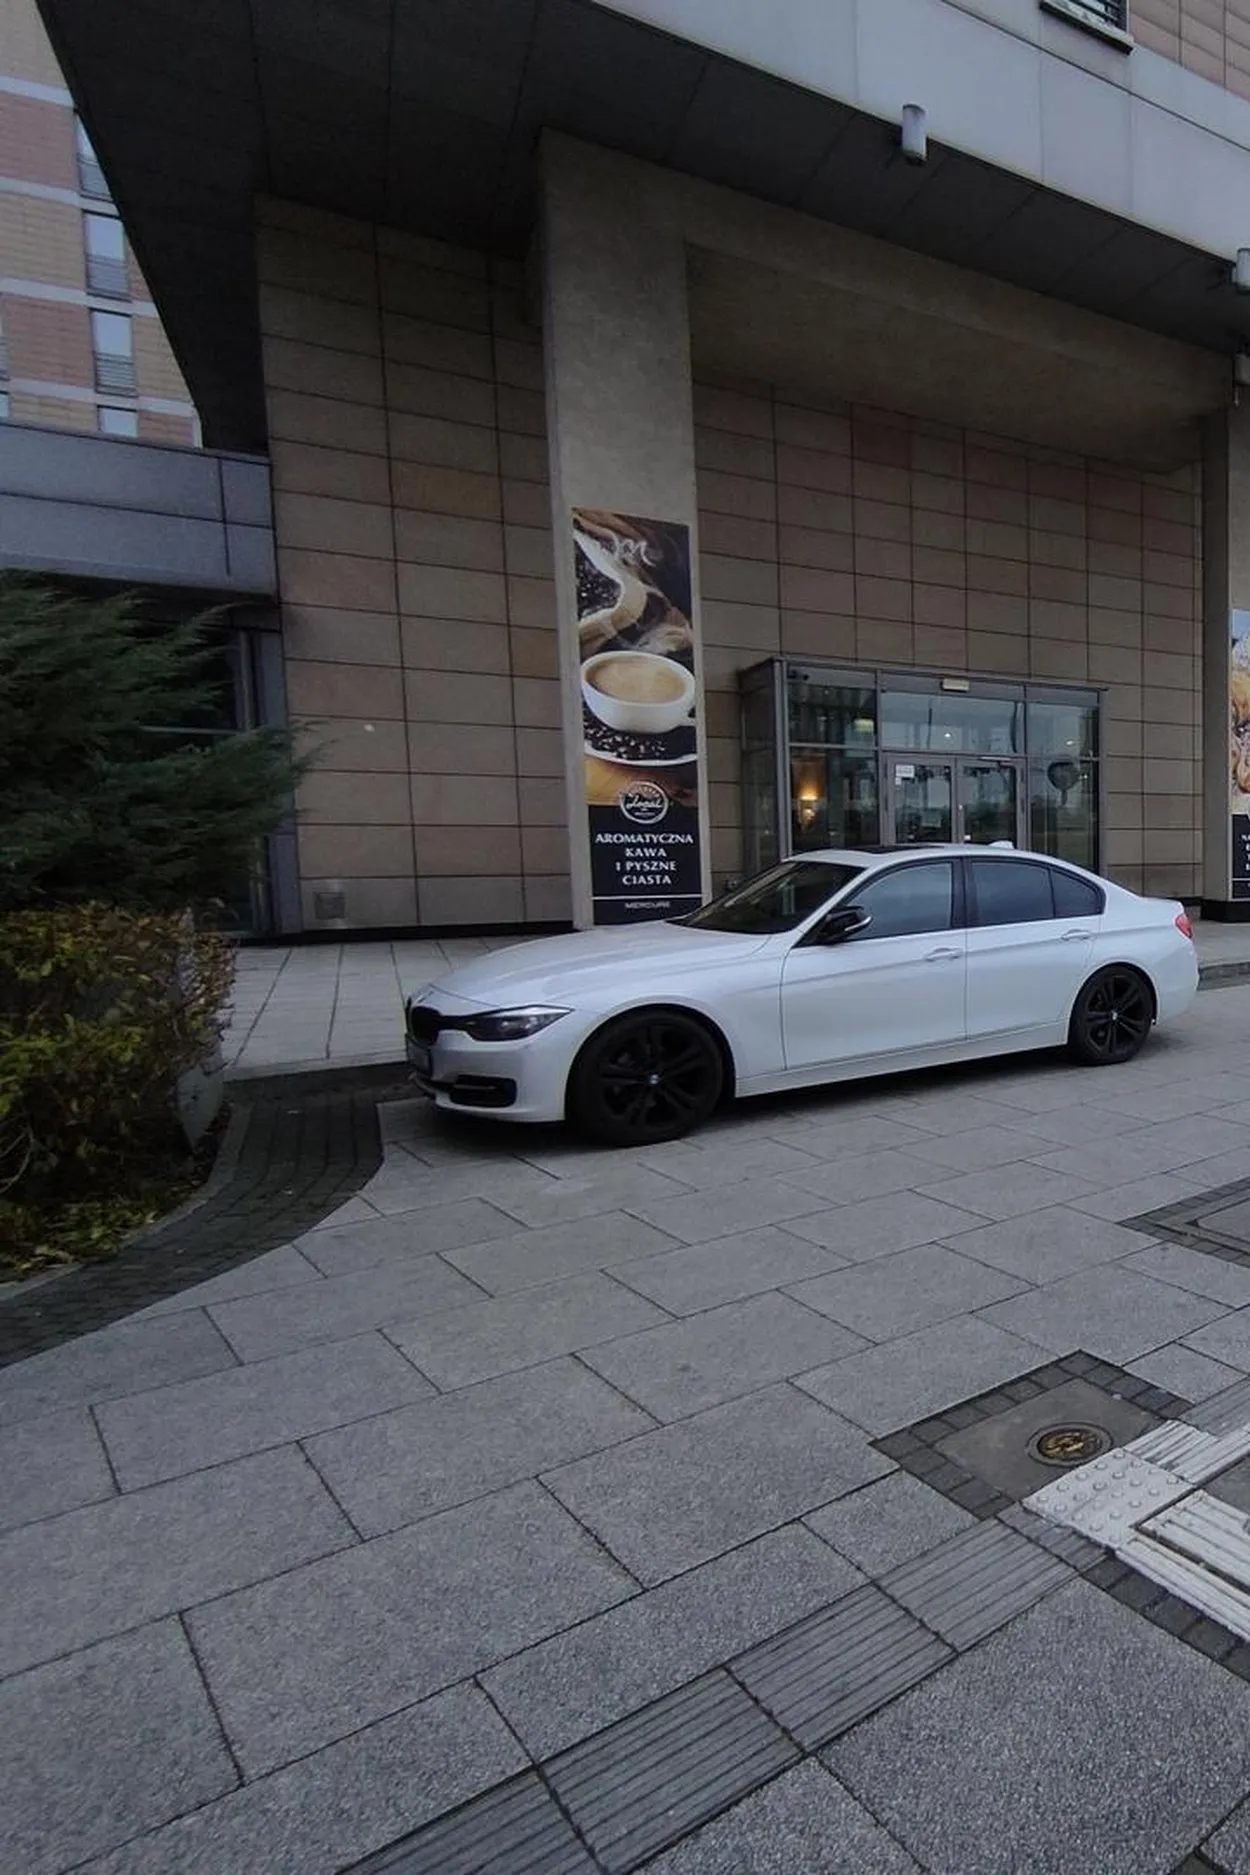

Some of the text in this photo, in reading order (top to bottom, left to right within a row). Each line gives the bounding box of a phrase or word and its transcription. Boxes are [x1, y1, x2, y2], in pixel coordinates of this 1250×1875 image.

[595, 833, 694, 844] AROMATYCZNA
[625, 848, 667, 857] KAWA
[615, 861, 677, 871] I PYSZNE
[622, 875, 672, 885] CIASTA
